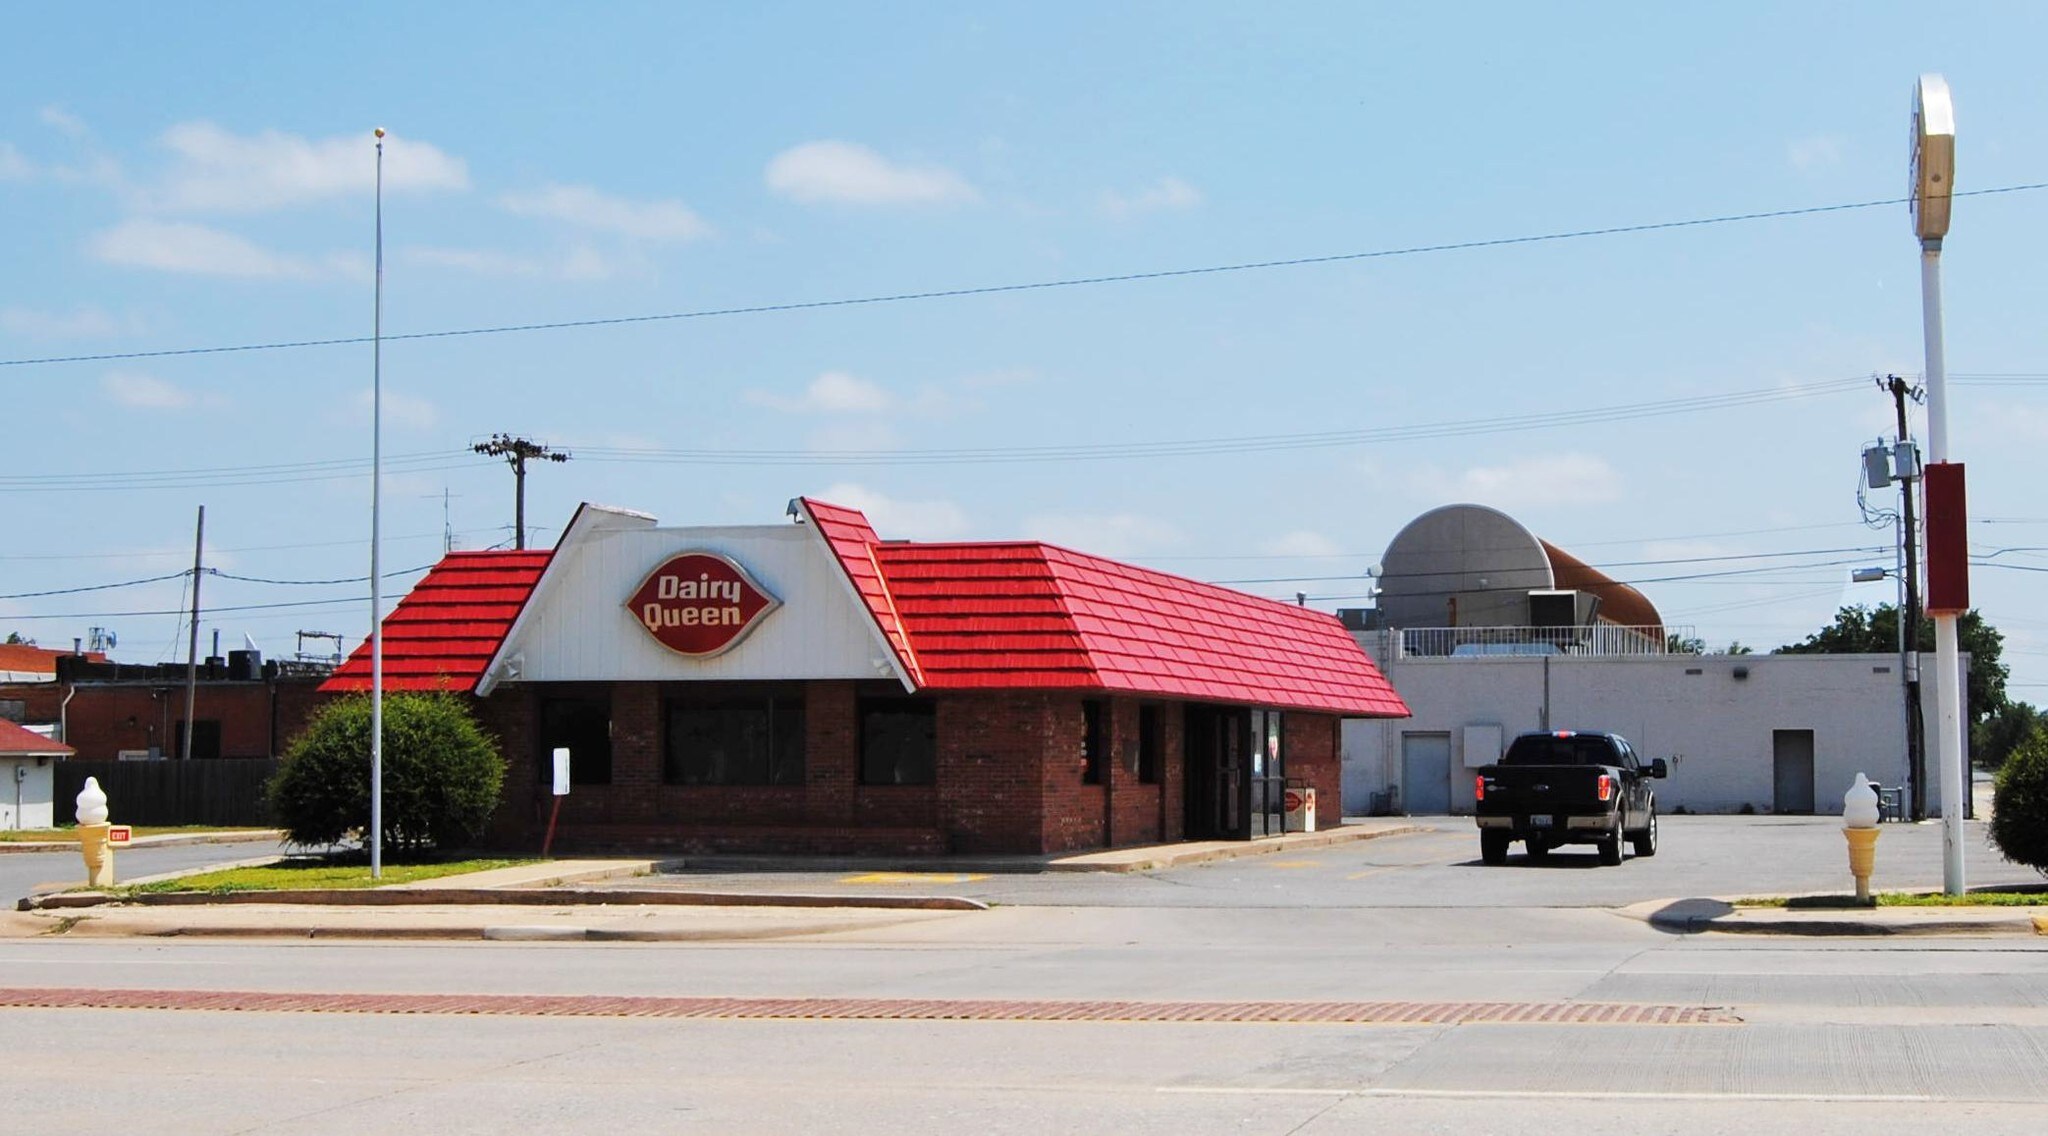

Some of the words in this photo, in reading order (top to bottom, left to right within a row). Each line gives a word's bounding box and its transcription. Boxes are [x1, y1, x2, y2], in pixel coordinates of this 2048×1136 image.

[658, 573, 741, 603] Dairy
[643, 603, 741, 632] Queen
[111, 831, 126, 840] EXIT
